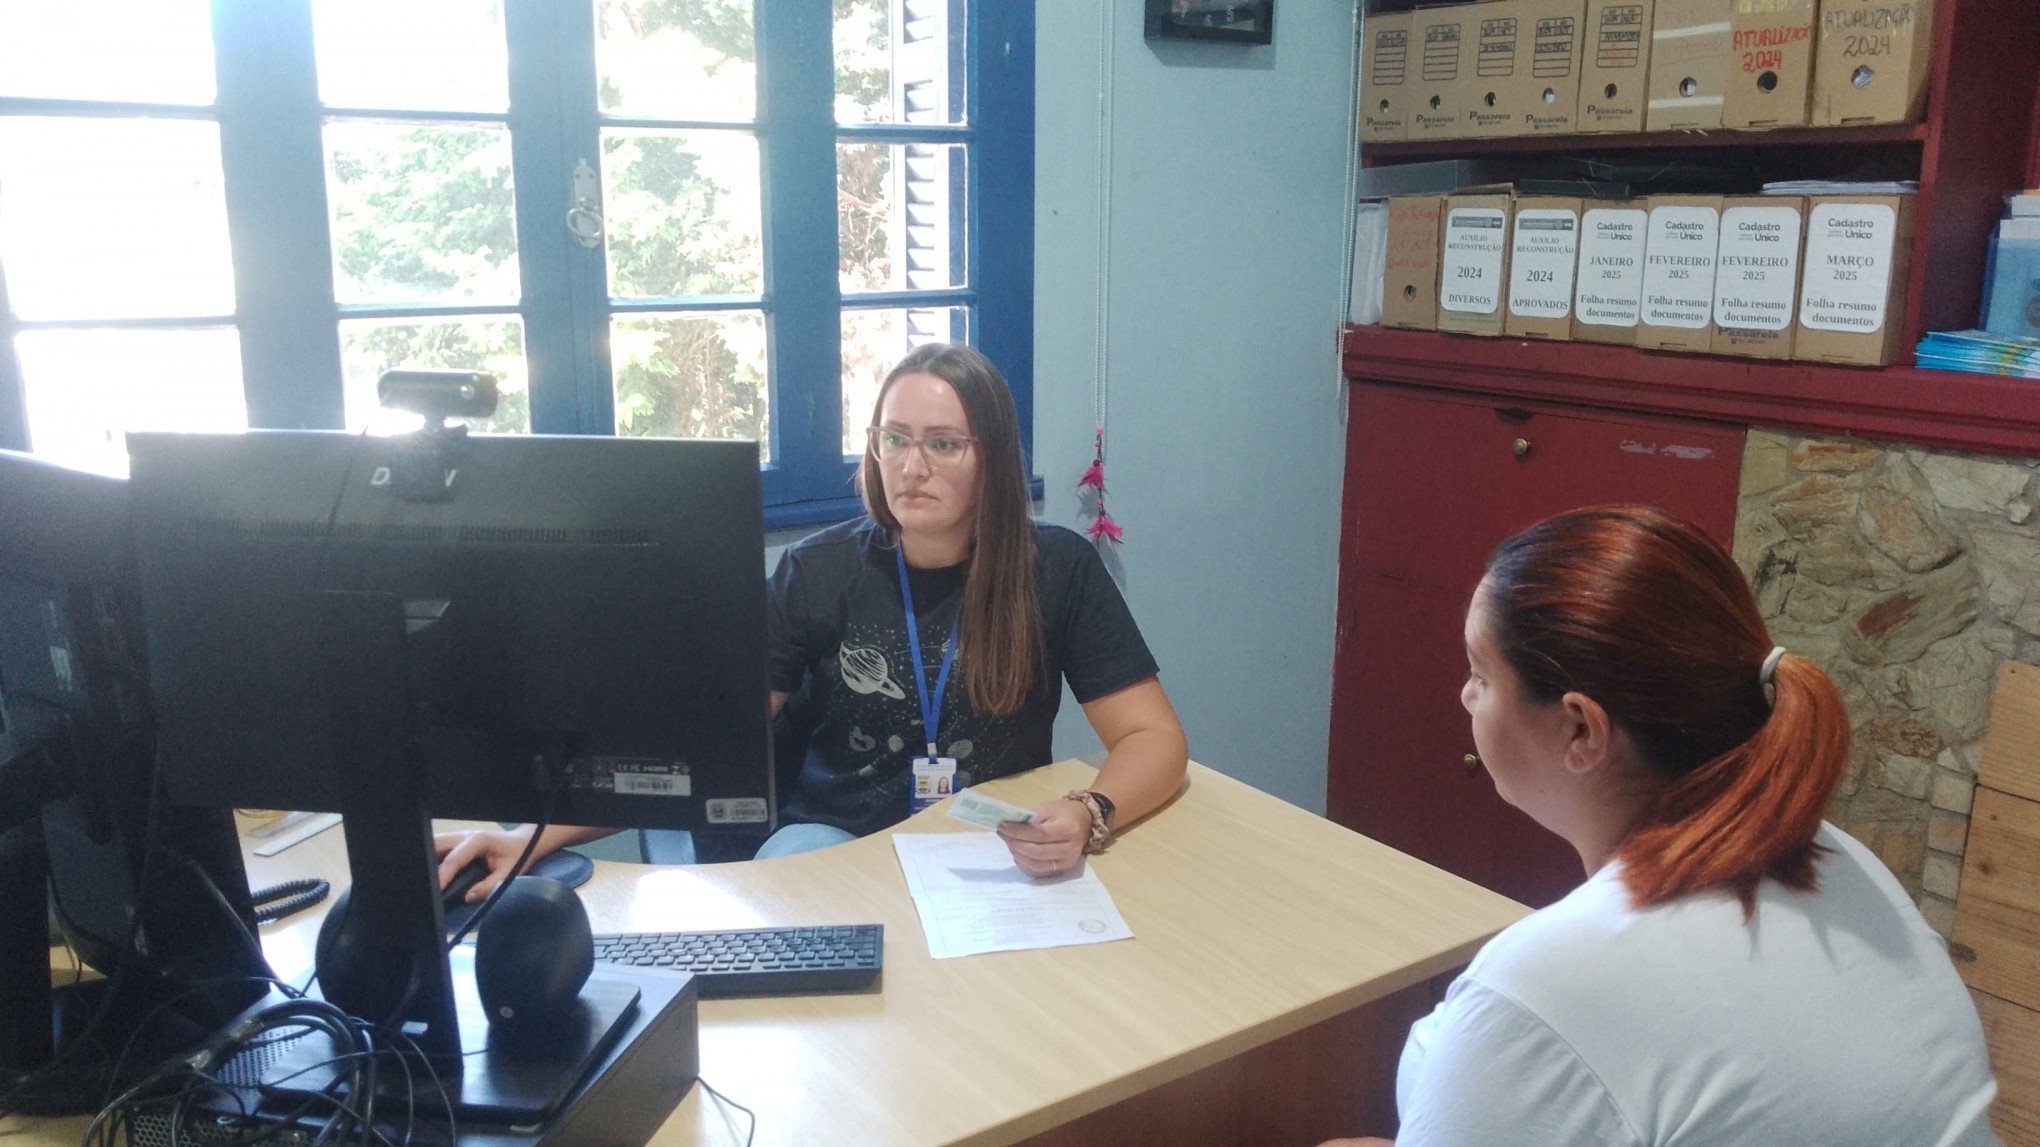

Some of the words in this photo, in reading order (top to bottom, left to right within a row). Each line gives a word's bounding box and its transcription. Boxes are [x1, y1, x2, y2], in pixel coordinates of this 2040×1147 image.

[1843, 35, 1890, 57] 2024
[1742, 51, 1782, 73] 2024
[1597, 222, 1633, 231] Cadastro
[1665, 221, 1704, 230] Cadastro
[1738, 222, 1780, 231] Cadastro
[1828, 218, 1873, 228] Cadastro
[1590, 257, 1634, 267] JANEIRO
[1649, 255, 1711, 267] FEVEREIRO
[1722, 256, 1788, 267] FEVEREIRO
[1826, 255, 1874, 267] MARÇO
[1457, 266, 1482, 279] 2024
[1526, 269, 1554, 282] 2024
[1601, 270, 1621, 279] 2025
[1668, 270, 1689, 279] 2025
[1742, 270, 1765, 280] 2025
[1833, 270, 1857, 280] 2025
[1449, 294, 1491, 305] DIVERSOS
[1512, 298, 1568, 309] APROVADOS
[1581, 294, 1604, 304] Folha
[1606, 297, 1637, 306] resumo
[1648, 295, 1673, 305] Folha
[1675, 298, 1708, 307] resumo
[1721, 298, 1748, 308] Folha
[1751, 300, 1787, 310] resumo
[1806, 297, 1835, 309] Folha
[1838, 301, 1877, 311] resumo
[1586, 308, 1635, 319] documentos
[1651, 309, 1704, 321] documentos
[1724, 312, 1781, 323] documentos
[1812, 313, 1874, 326] documentos
